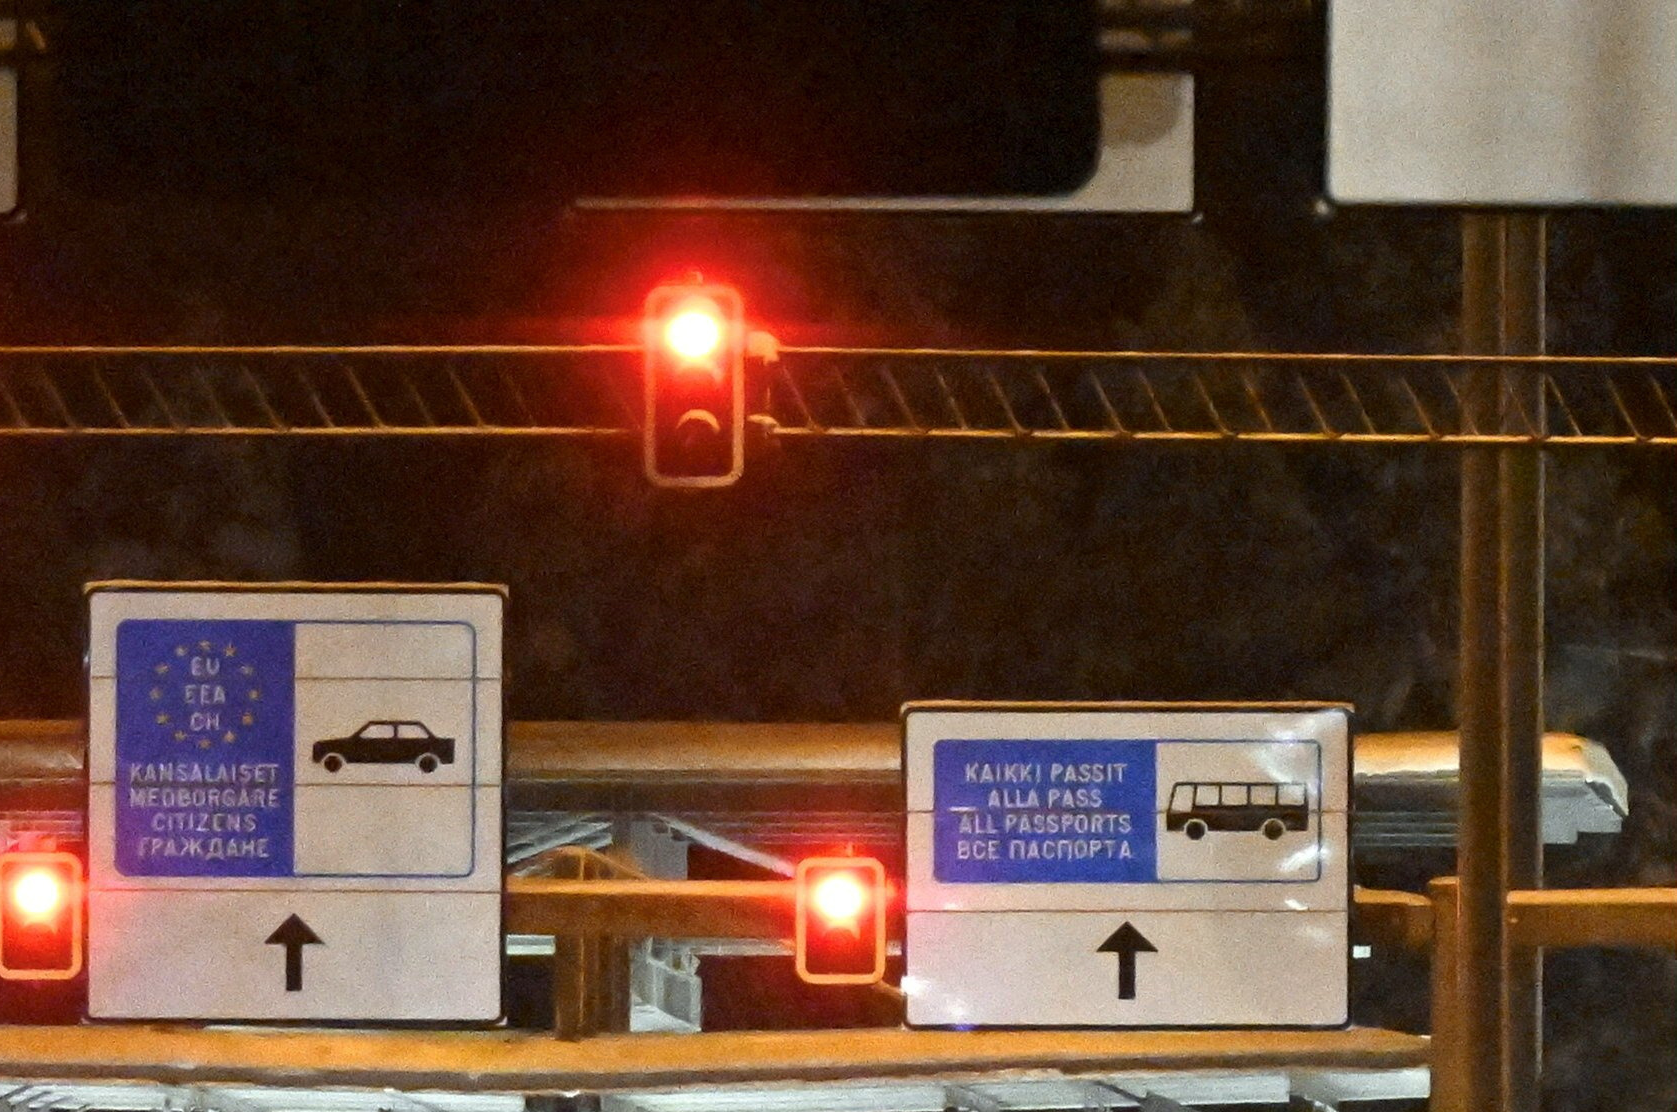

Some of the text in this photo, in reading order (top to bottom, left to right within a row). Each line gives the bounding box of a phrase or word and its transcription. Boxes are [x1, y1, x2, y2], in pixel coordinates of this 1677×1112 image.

[191, 657, 220, 676] EU
[184, 685, 226, 705] EEA
[190, 711, 219, 731] CH
[130, 762, 279, 783] KANSALAISET
[966, 763, 1127, 783] KAIKKI PASSIT
[130, 788, 280, 808] MEDBORGARE
[988, 789, 1102, 809] ALLA PASS
[151, 813, 257, 832] CITIZENS
[958, 813, 1132, 834] ALL PASSPORTS
[138, 837, 270, 859] ГРАЖДАНЕ
[958, 840, 1133, 861] ВСЕ ПАСПОРТА
